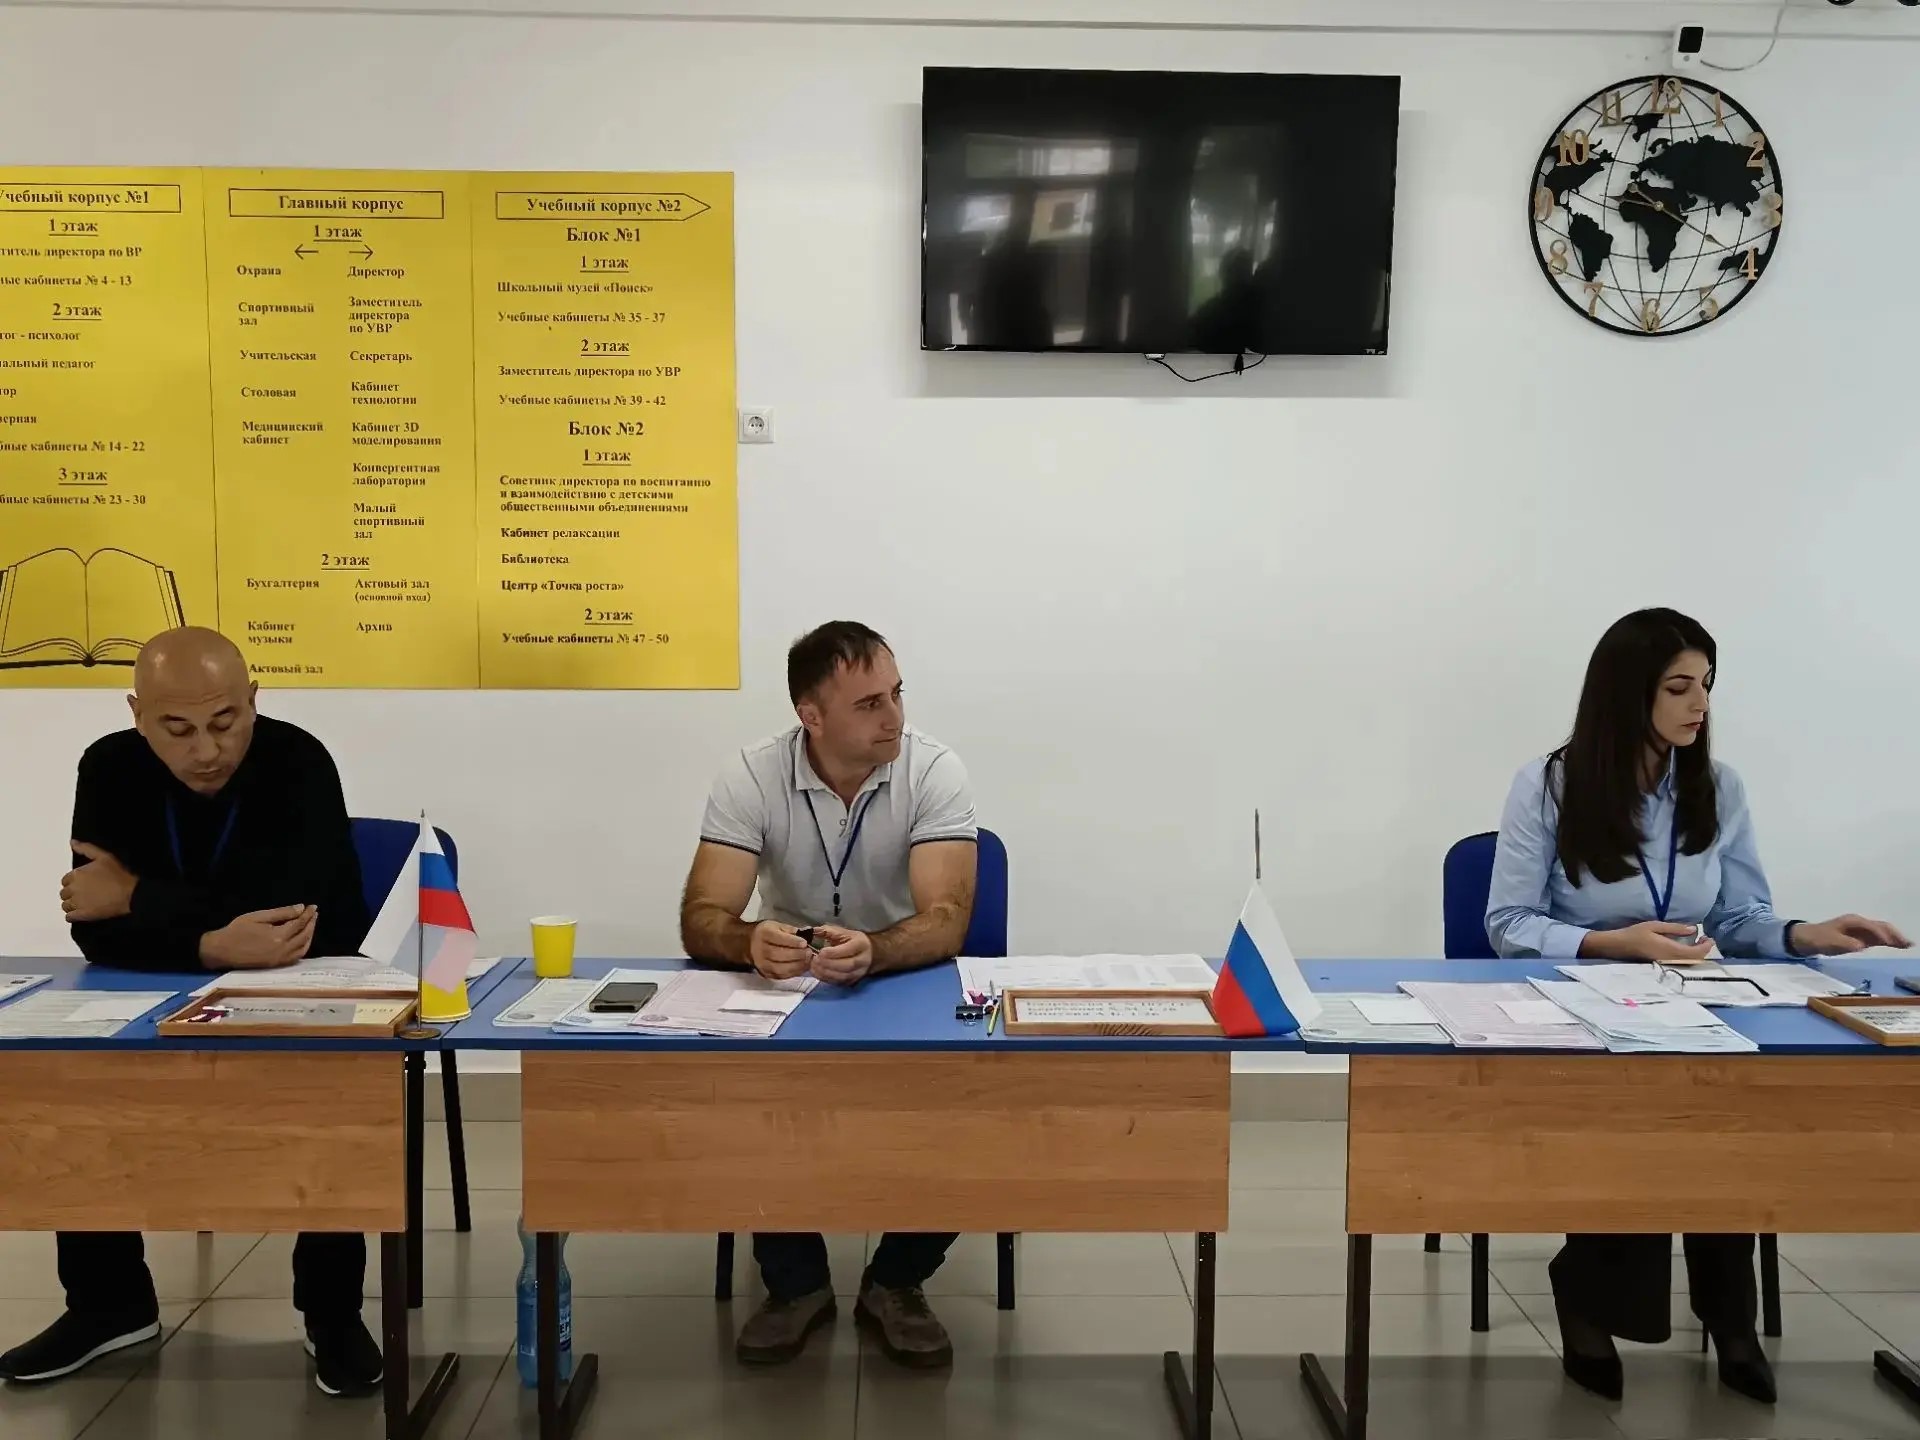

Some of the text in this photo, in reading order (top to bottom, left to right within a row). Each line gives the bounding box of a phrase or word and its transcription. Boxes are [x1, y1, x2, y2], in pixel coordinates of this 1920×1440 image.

[1650, 77, 1682, 115] 12
[1600, 90, 1625, 128] 11
[1712, 91, 1725, 129] 1
[1556, 129, 1590, 167] 10
[1746, 131, 1766, 168] 2
[67, 193, 121, 207] корпус
[124, 190, 149, 204] №1
[279, 195, 404, 214] Главный корпус
[526, 198, 681, 216] Учебный корпус №2
[1762, 191, 1782, 229] 3
[48, 218, 98, 233] 1 этаж
[313, 224, 362, 238] 1 этаж
[566, 227, 641, 243] Блок №1
[44, 248, 106, 260] директора
[108, 248, 123, 257] по
[125, 246, 143, 257] ВР
[1549, 238, 1568, 276] 8
[581, 255, 629, 269] 1 этаж
[1738, 248, 1759, 281] 4
[236, 264, 282, 278] Охрана
[346, 265, 405, 280] Директор
[24, 274, 82, 286] кабинеты
[84, 274, 99, 286] №
[100, 274, 108, 286] 4
[119, 274, 132, 286] 13
[497, 281, 654, 296] Школьный музей «Поиск»
[348, 295, 423, 308] Заместитель
[1583, 281, 1604, 318] 7
[52, 302, 102, 317] 2 этаж
[238, 301, 315, 315] Спортивный
[238, 317, 258, 326] зал
[348, 312, 410, 323] директора
[498, 311, 550, 322] Учебные
[552, 311, 610, 323] кабинеты
[612, 312, 626, 323] №
[628, 312, 642, 323] 35
[652, 312, 666, 323] 37
[349, 322, 393, 334] по УВР
[28, 332, 79, 341] психолог
[580, 338, 630, 352] 2 этаж
[239, 349, 317, 361] Учительская
[349, 350, 413, 364] Секретарь
[51, 360, 96, 369] педагог
[498, 365, 682, 379] Заместитель директора по УВР
[240, 386, 297, 398] Столовая
[351, 381, 400, 392] Кабинет
[352, 396, 417, 405] технологии
[498, 394, 551, 405] Учебные
[553, 395, 611, 406] кабинеты
[613, 395, 627, 406] №
[629, 395, 643, 406] 39
[652, 395, 667, 406] 42
[242, 420, 324, 433] Медицинский
[351, 421, 420, 433] Кабинет 3D
[569, 421, 644, 436] Блок №2
[242, 433, 289, 445] кабинет
[352, 437, 442, 448] моделирования
[30, 440, 88, 452] кабинеты
[90, 440, 106, 452] №
[109, 441, 122, 452] 14
[132, 440, 145, 452] 22
[583, 448, 631, 462] 1 этаж
[58, 467, 108, 481] 3 этаж
[352, 462, 440, 475] Конвергентная
[352, 475, 426, 488] лаборатория
[499, 474, 711, 489] Советник директора по воспитанию
[32, 494, 90, 505] кабинеты
[92, 494, 106, 505] №
[109, 494, 123, 505] 23
[132, 494, 146, 505] 30
[500, 488, 674, 500] и взаимодействию с детскими
[353, 502, 397, 513] Малый
[500, 501, 689, 513] общественными объединениями
[353, 516, 425, 529] спортивный
[353, 531, 373, 539] зал
[500, 527, 621, 541] Кабинет релаксации
[321, 553, 370, 566] 2 этаж
[501, 553, 569, 565] Библиотека
[246, 577, 320, 591] Бухгалтерия
[355, 578, 430, 589] Актовый зал
[501, 579, 624, 593] Центр «Точка роста»
[354, 591, 403, 604] (основной
[584, 607, 633, 621] 2 этаж
[247, 620, 295, 632] Кабинет
[356, 621, 393, 634] Архив
[248, 635, 293, 646] музыки
[502, 632, 555, 644] Учебные
[557, 632, 614, 644] кабинеты
[616, 633, 630, 644] №
[632, 633, 646, 644] 47
[656, 633, 670, 644] 50
[250, 663, 323, 674] Актовый зал
